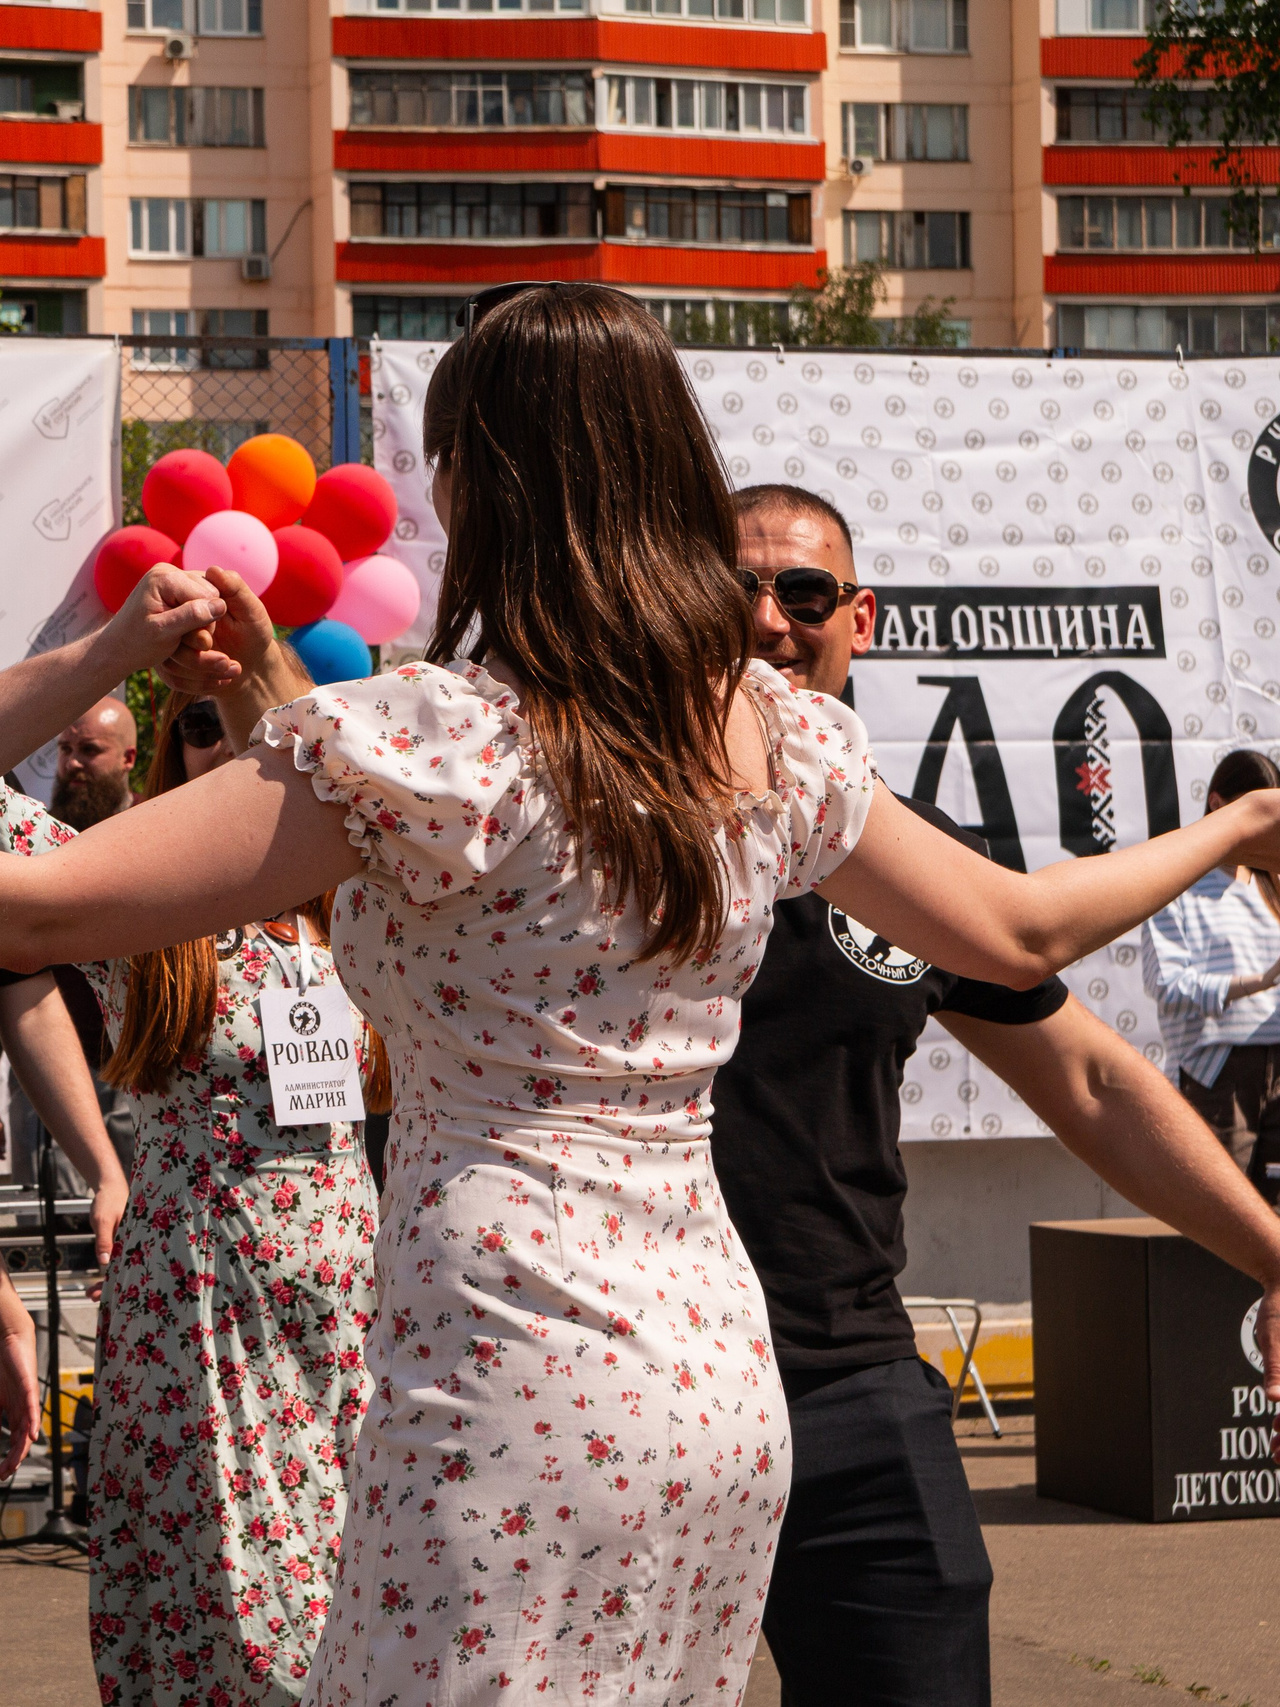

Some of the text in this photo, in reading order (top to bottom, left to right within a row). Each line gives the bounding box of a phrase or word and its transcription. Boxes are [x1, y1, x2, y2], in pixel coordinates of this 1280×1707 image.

[950, 604, 1156, 658] ОБЩИНА
[839, 670, 1182, 875] АО
[837, 932, 907, 980] ВОСТОЧНЫЙ
[284, 1079, 346, 1092] АДМИНИСТРАТОР
[289, 1091, 347, 1111] МАРИЯ
